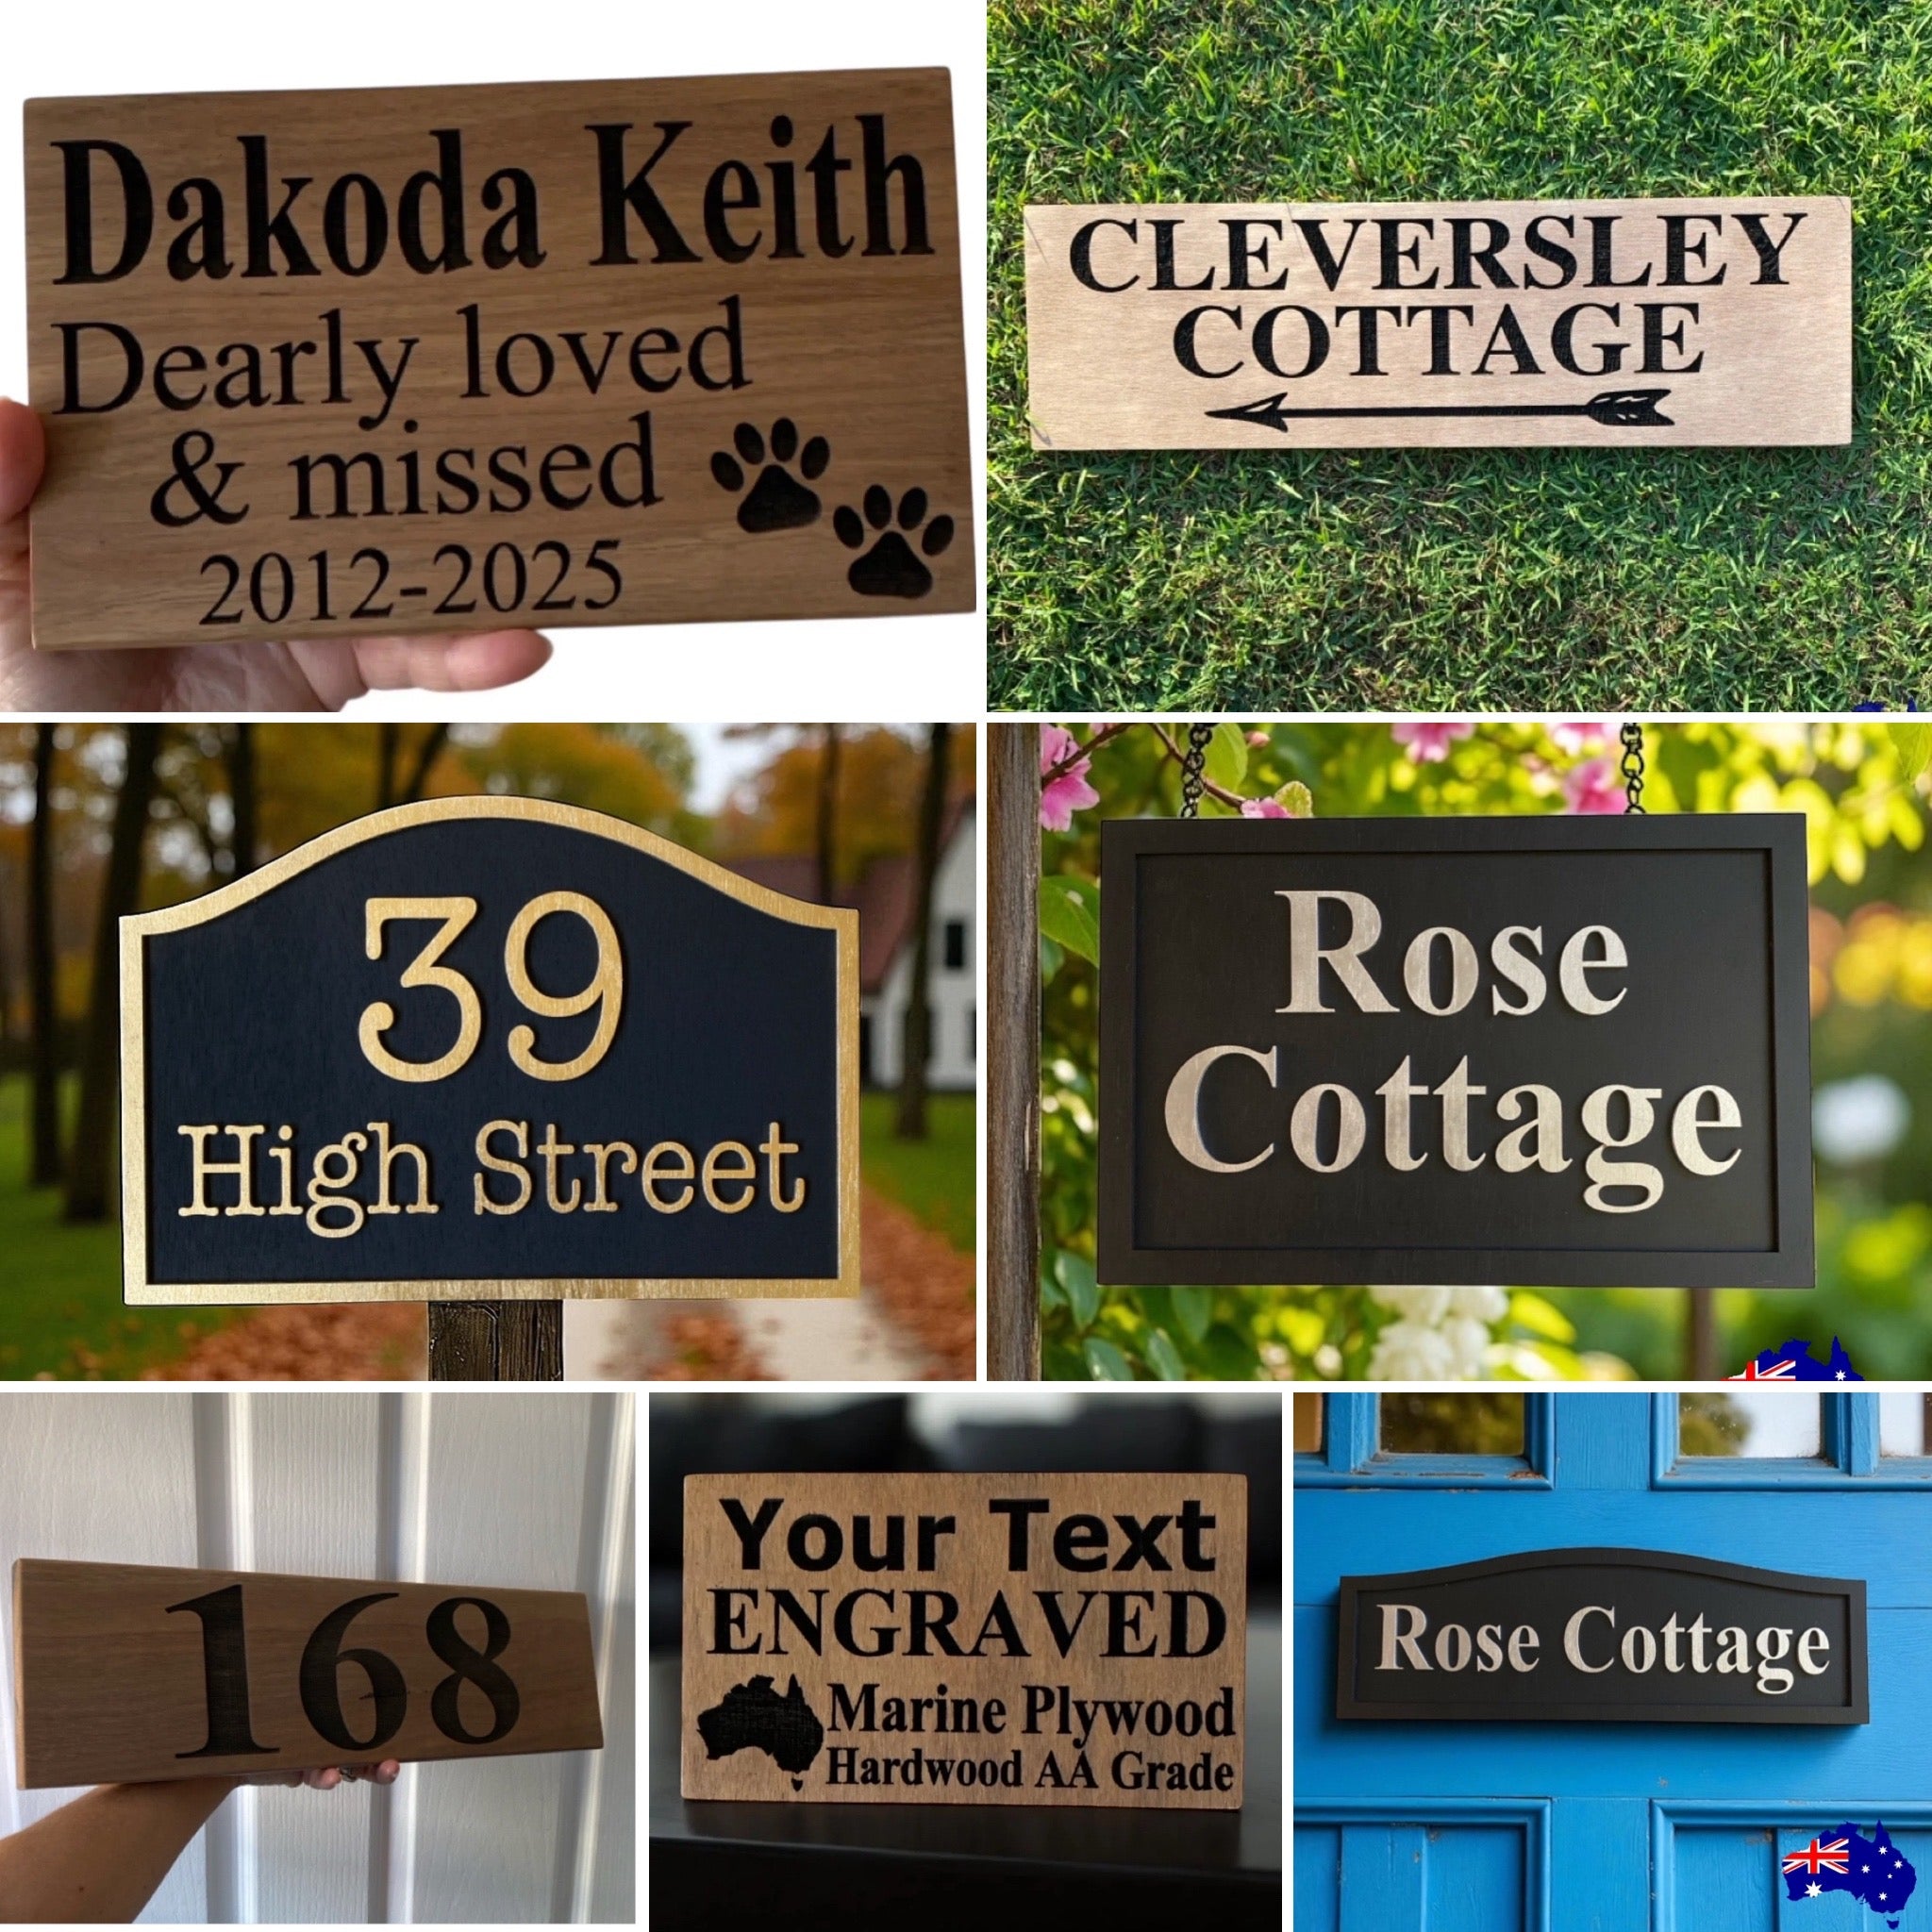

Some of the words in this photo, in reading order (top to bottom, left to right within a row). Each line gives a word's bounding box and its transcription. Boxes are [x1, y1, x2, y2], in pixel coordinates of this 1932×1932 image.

[50, 128, 546, 286] Dakoda
[585, 114, 935, 267] Keith
[1070, 212, 1807, 293] CLEVERSLEY
[51, 308, 420, 428] Dearly
[457, 294, 753, 400] loved
[1173, 302, 1704, 379] COTTAGE
[150, 429, 250, 527] &
[288, 410, 664, 522] missed
[199, 539, 624, 625] 2012-2025
[358, 891, 624, 1082] 39
[1274, 890, 1628, 1018] Rose
[177, 1123, 439, 1238] High
[474, 1119, 806, 1216] Street
[1164, 1043, 1743, 1214] Cottage
[719, 1498, 956, 1572] Your
[989, 1499, 1216, 1573] Text
[165, 1585, 520, 1759] 168
[706, 1588, 1226, 1658] ENGRAVED
[1374, 1604, 1541, 1674] Rose
[1564, 1606, 1831, 1695] Cottage
[826, 1683, 1007, 1735] Marine
[1022, 1686, 1236, 1750] Plywood
[825, 1747, 1023, 1787] Hardwood
[1035, 1750, 1099, 1789] AA
[1111, 1750, 1235, 1791] Grade
